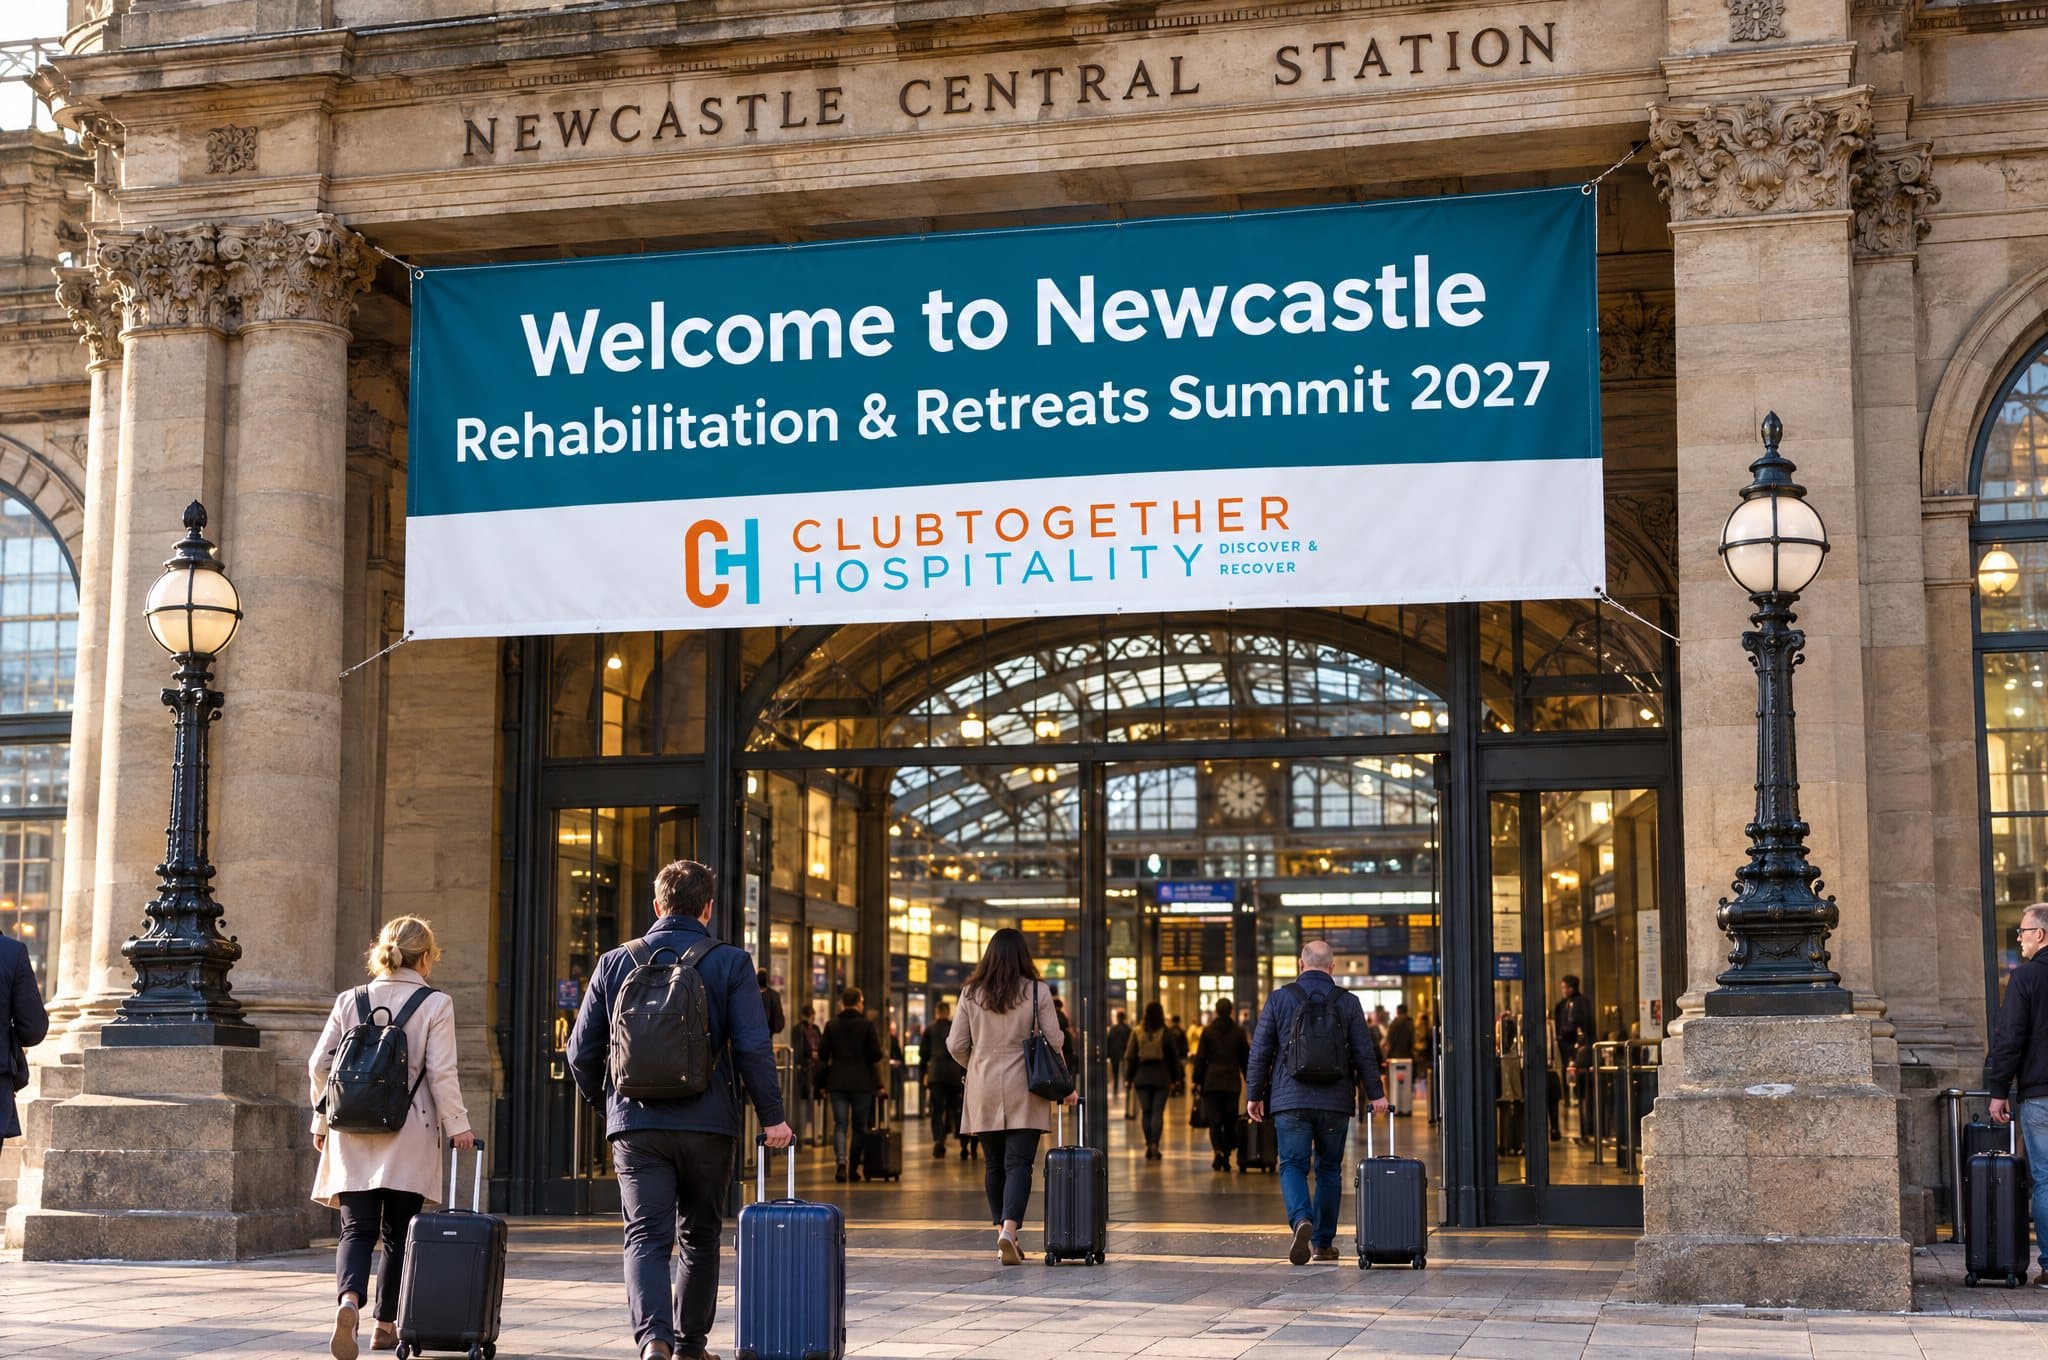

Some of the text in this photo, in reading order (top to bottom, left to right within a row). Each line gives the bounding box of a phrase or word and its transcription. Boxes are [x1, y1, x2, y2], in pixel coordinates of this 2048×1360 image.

[463, 22, 1556, 162] NEWCASTLE CENTRAL STATION
[520, 255, 1487, 377] Welcome to Newcastle
[457, 361, 1550, 463] Rehabilitation & Retreats Summit 2027
[792, 496, 1290, 554] CLUBTOGETHER
[1219, 540, 1319, 555] DISCOVER &
[793, 543, 1206, 596] HOSPITALITY
[1220, 561, 1296, 576] RECOVER
